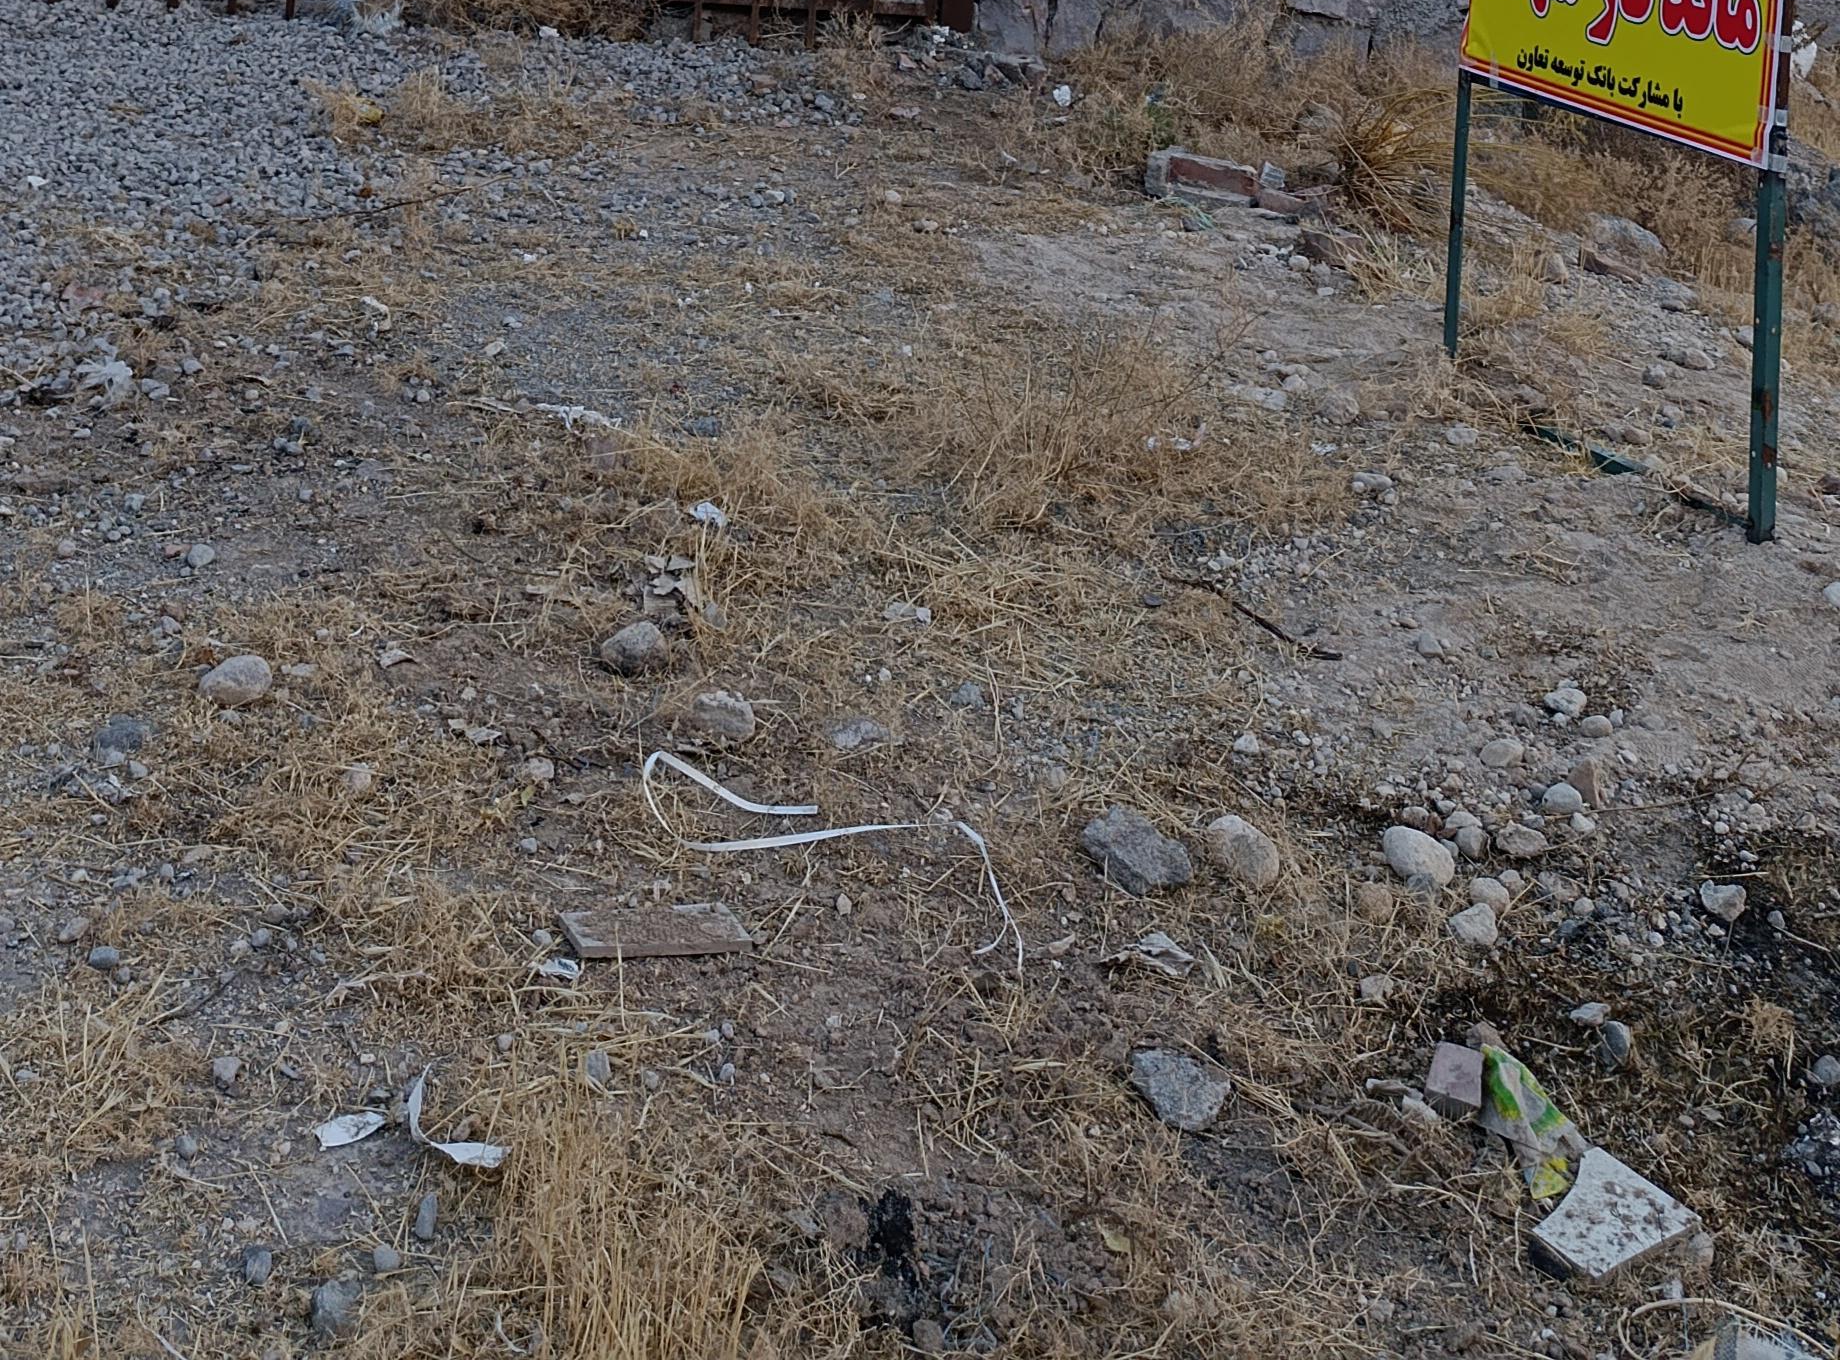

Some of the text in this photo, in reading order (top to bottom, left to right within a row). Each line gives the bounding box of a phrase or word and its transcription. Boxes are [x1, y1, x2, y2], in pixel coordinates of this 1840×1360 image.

[1516, 45, 1683, 118] با مشارکت بانک توسعه تعاون
